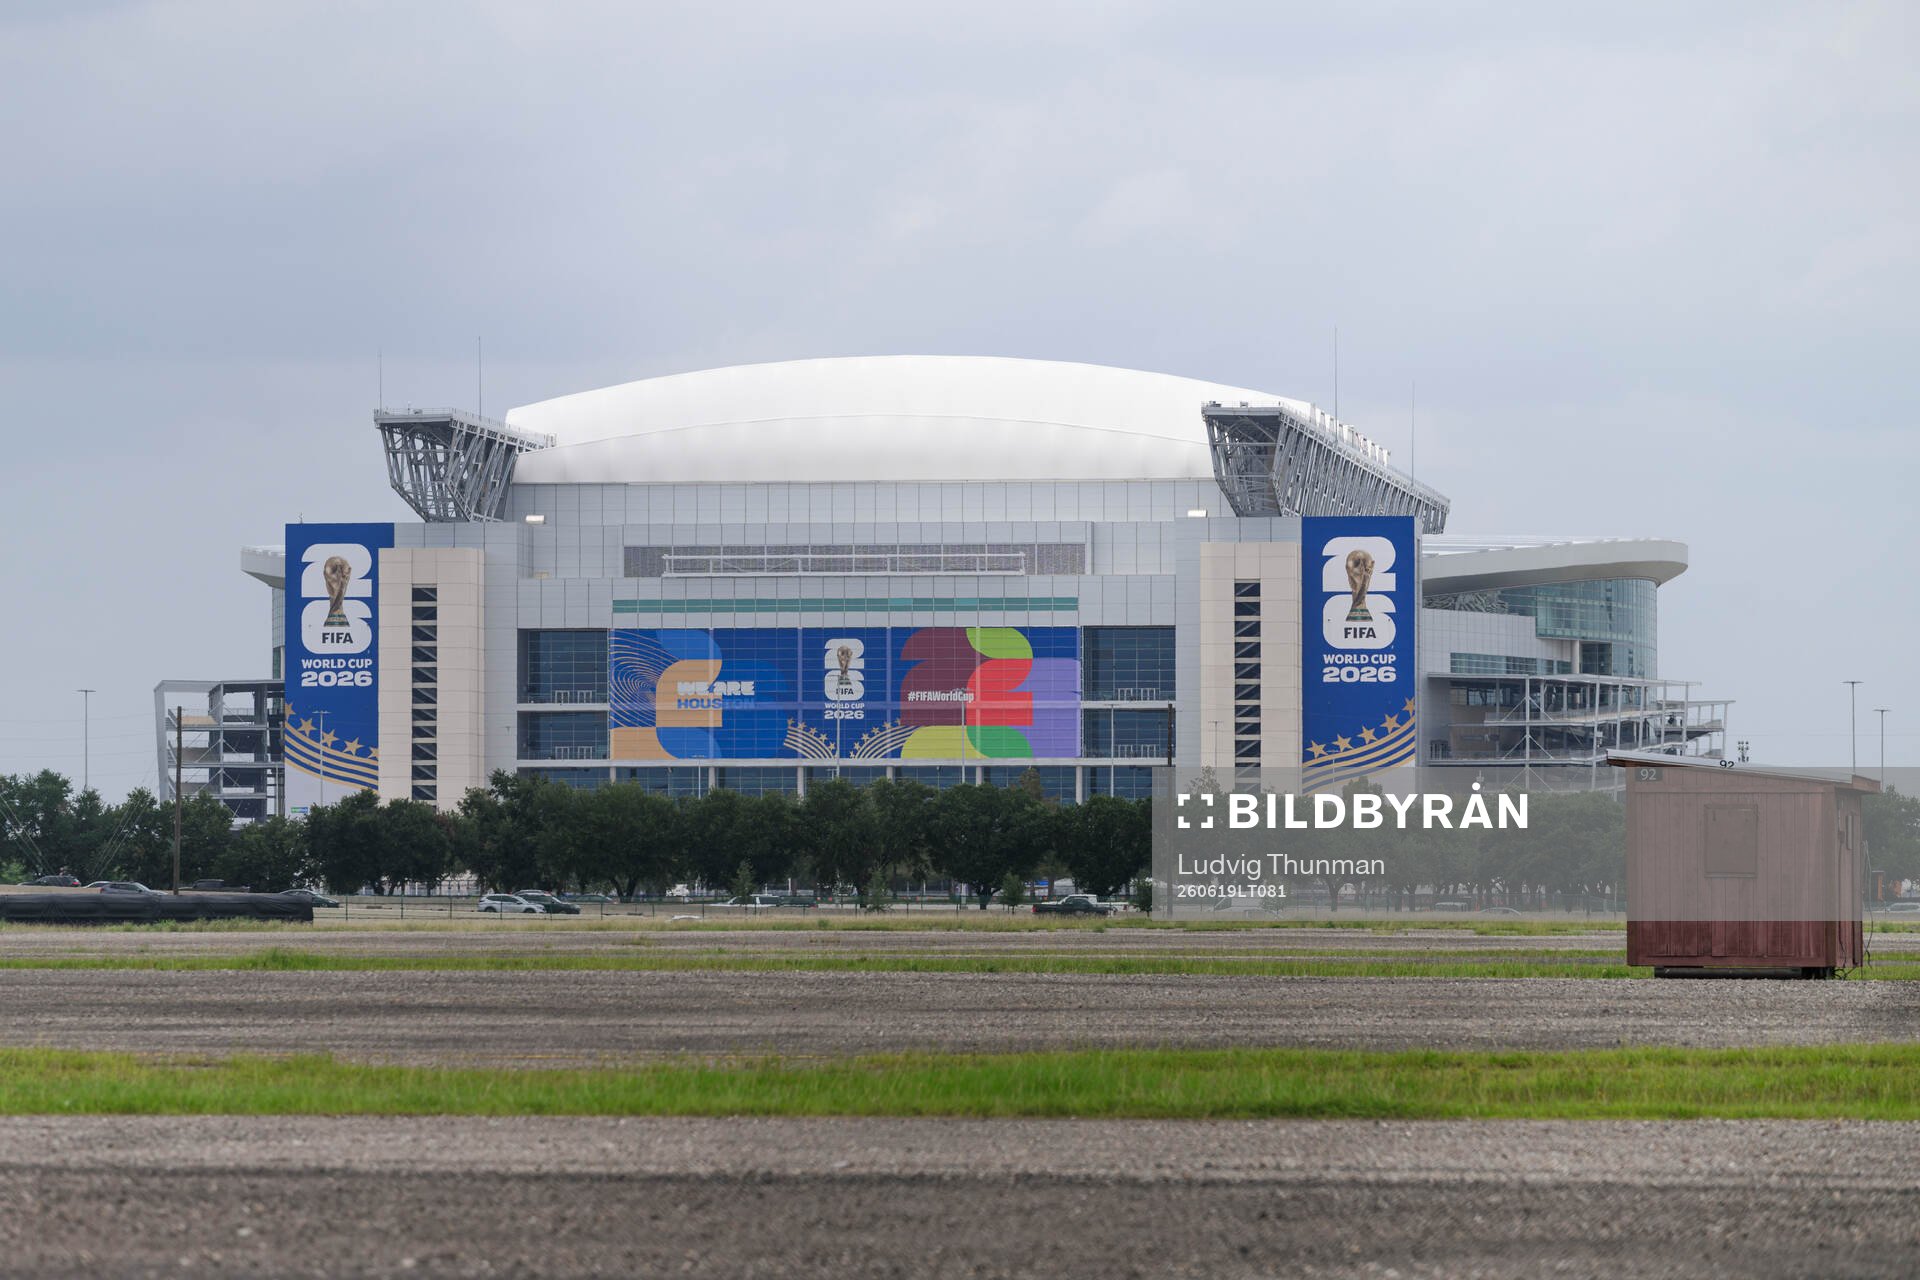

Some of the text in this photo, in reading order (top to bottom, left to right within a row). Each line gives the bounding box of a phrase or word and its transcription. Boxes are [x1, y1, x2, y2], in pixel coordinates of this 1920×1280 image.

[322, 632, 353, 644] FIFA
[1344, 627, 1376, 639] FIFA
[301, 658, 372, 669] WORLD CUP
[1323, 654, 1396, 665] WORLD CUP
[301, 671, 372, 687] 2026
[1322, 667, 1396, 683] 2026
[677, 681, 755, 696] WE ARE
[908, 691, 974, 703] #FIFAWorldCup
[824, 710, 864, 719] 2026
[1719, 759, 1735, 769] 92
[1640, 768, 1657, 780] 92
